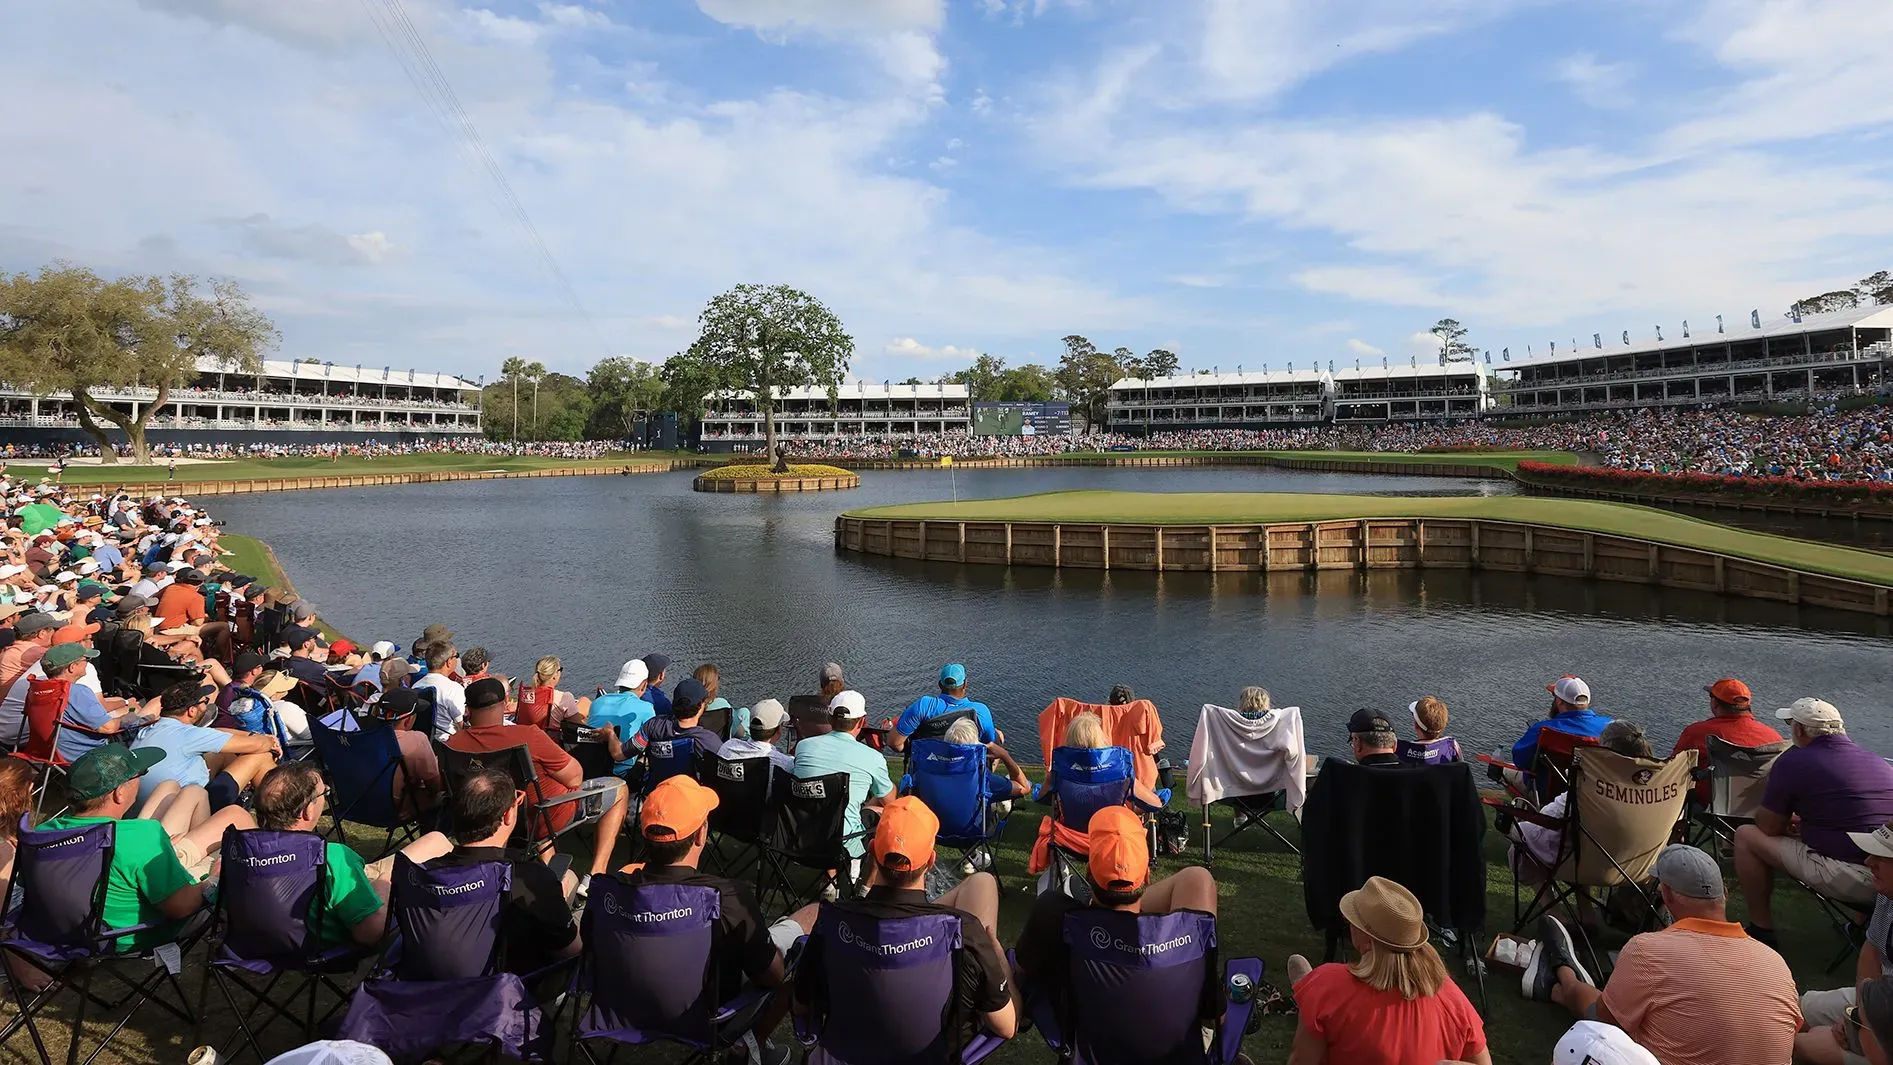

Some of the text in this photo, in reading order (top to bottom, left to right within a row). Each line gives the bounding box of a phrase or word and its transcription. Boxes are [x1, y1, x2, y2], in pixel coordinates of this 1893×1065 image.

[1596, 779, 1678, 804] SEMINOLES
[249, 853, 296, 867] Thornton
[436, 880, 484, 896] Thornton
[642, 907, 692, 922] Thornton
[855, 936, 933, 956] Grant Thornton
[1114, 934, 1192, 955] Grant Thornton
